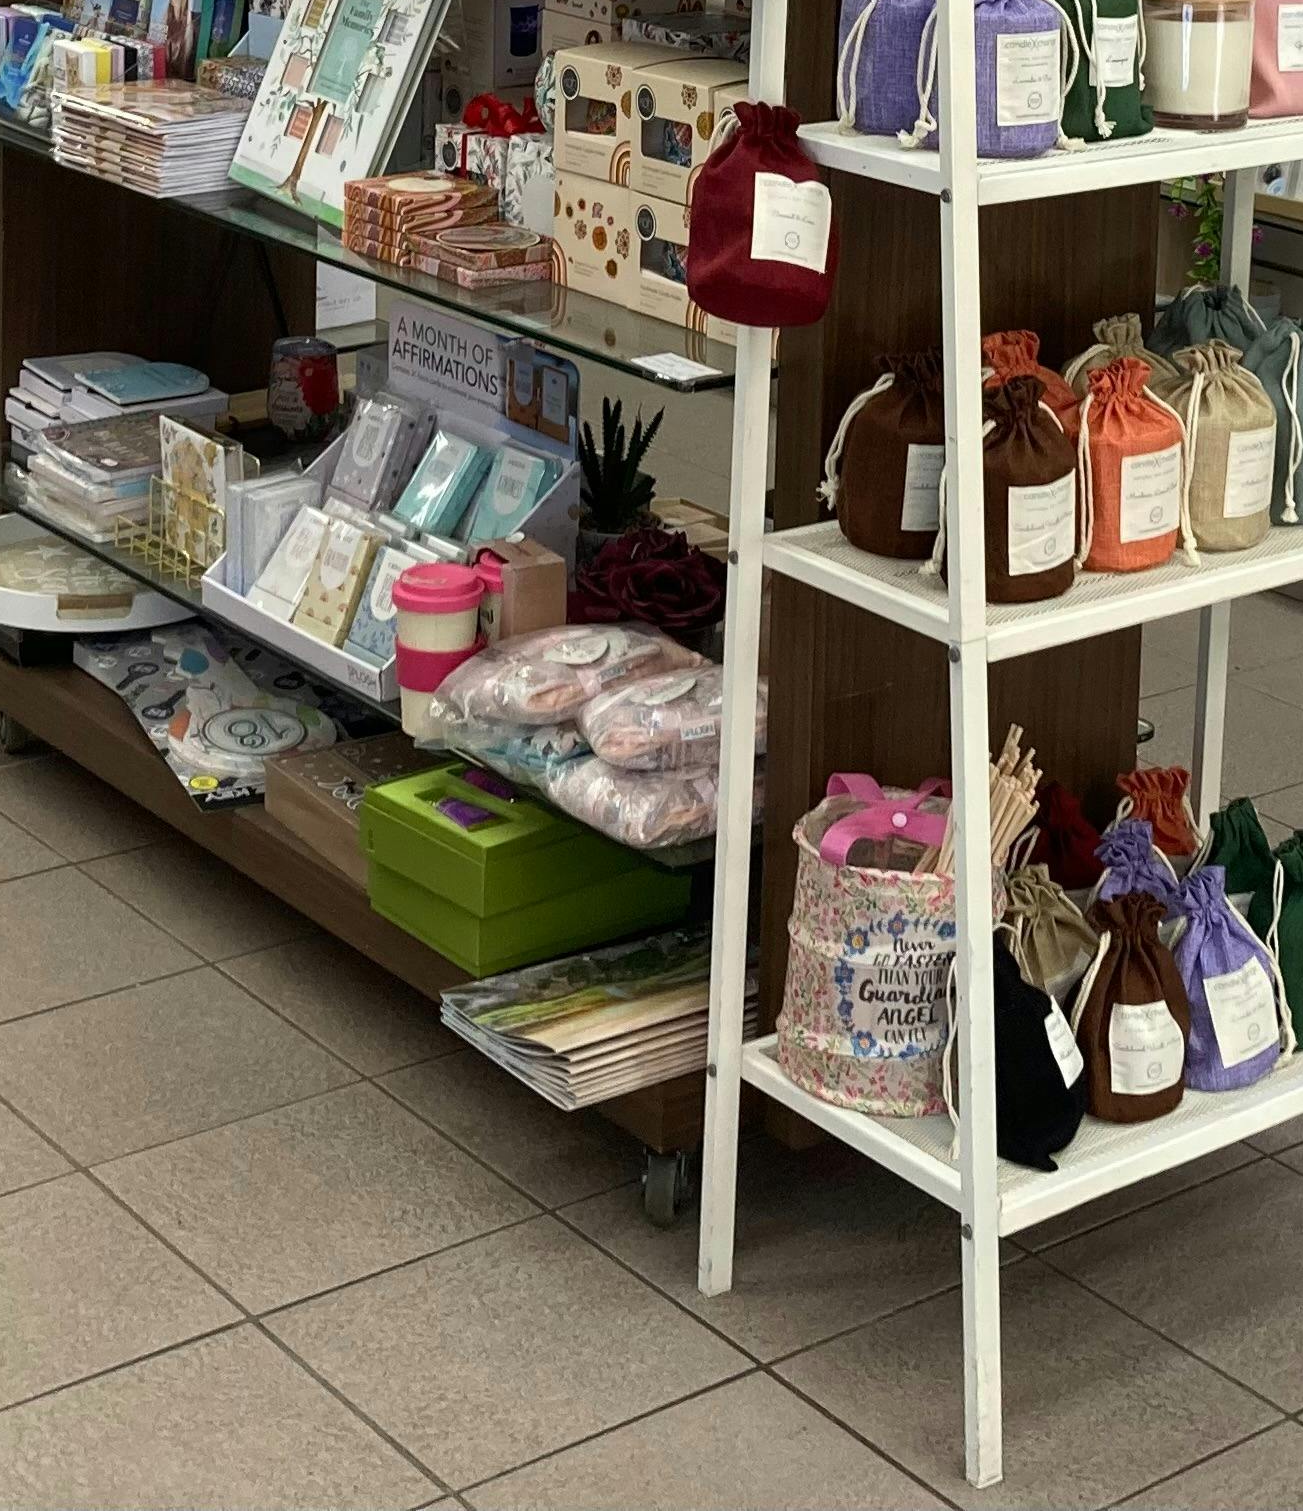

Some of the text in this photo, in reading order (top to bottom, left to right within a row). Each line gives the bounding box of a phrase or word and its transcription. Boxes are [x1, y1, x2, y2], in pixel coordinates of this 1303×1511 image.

[397, 316, 494, 368] A MONTH OF
[392, 339, 498, 396] AFFIRMATIONS
[894, 938, 936, 953] Never
[878, 968, 943, 985] THAN YOUR
[877, 1003, 938, 1026] ANGEL
